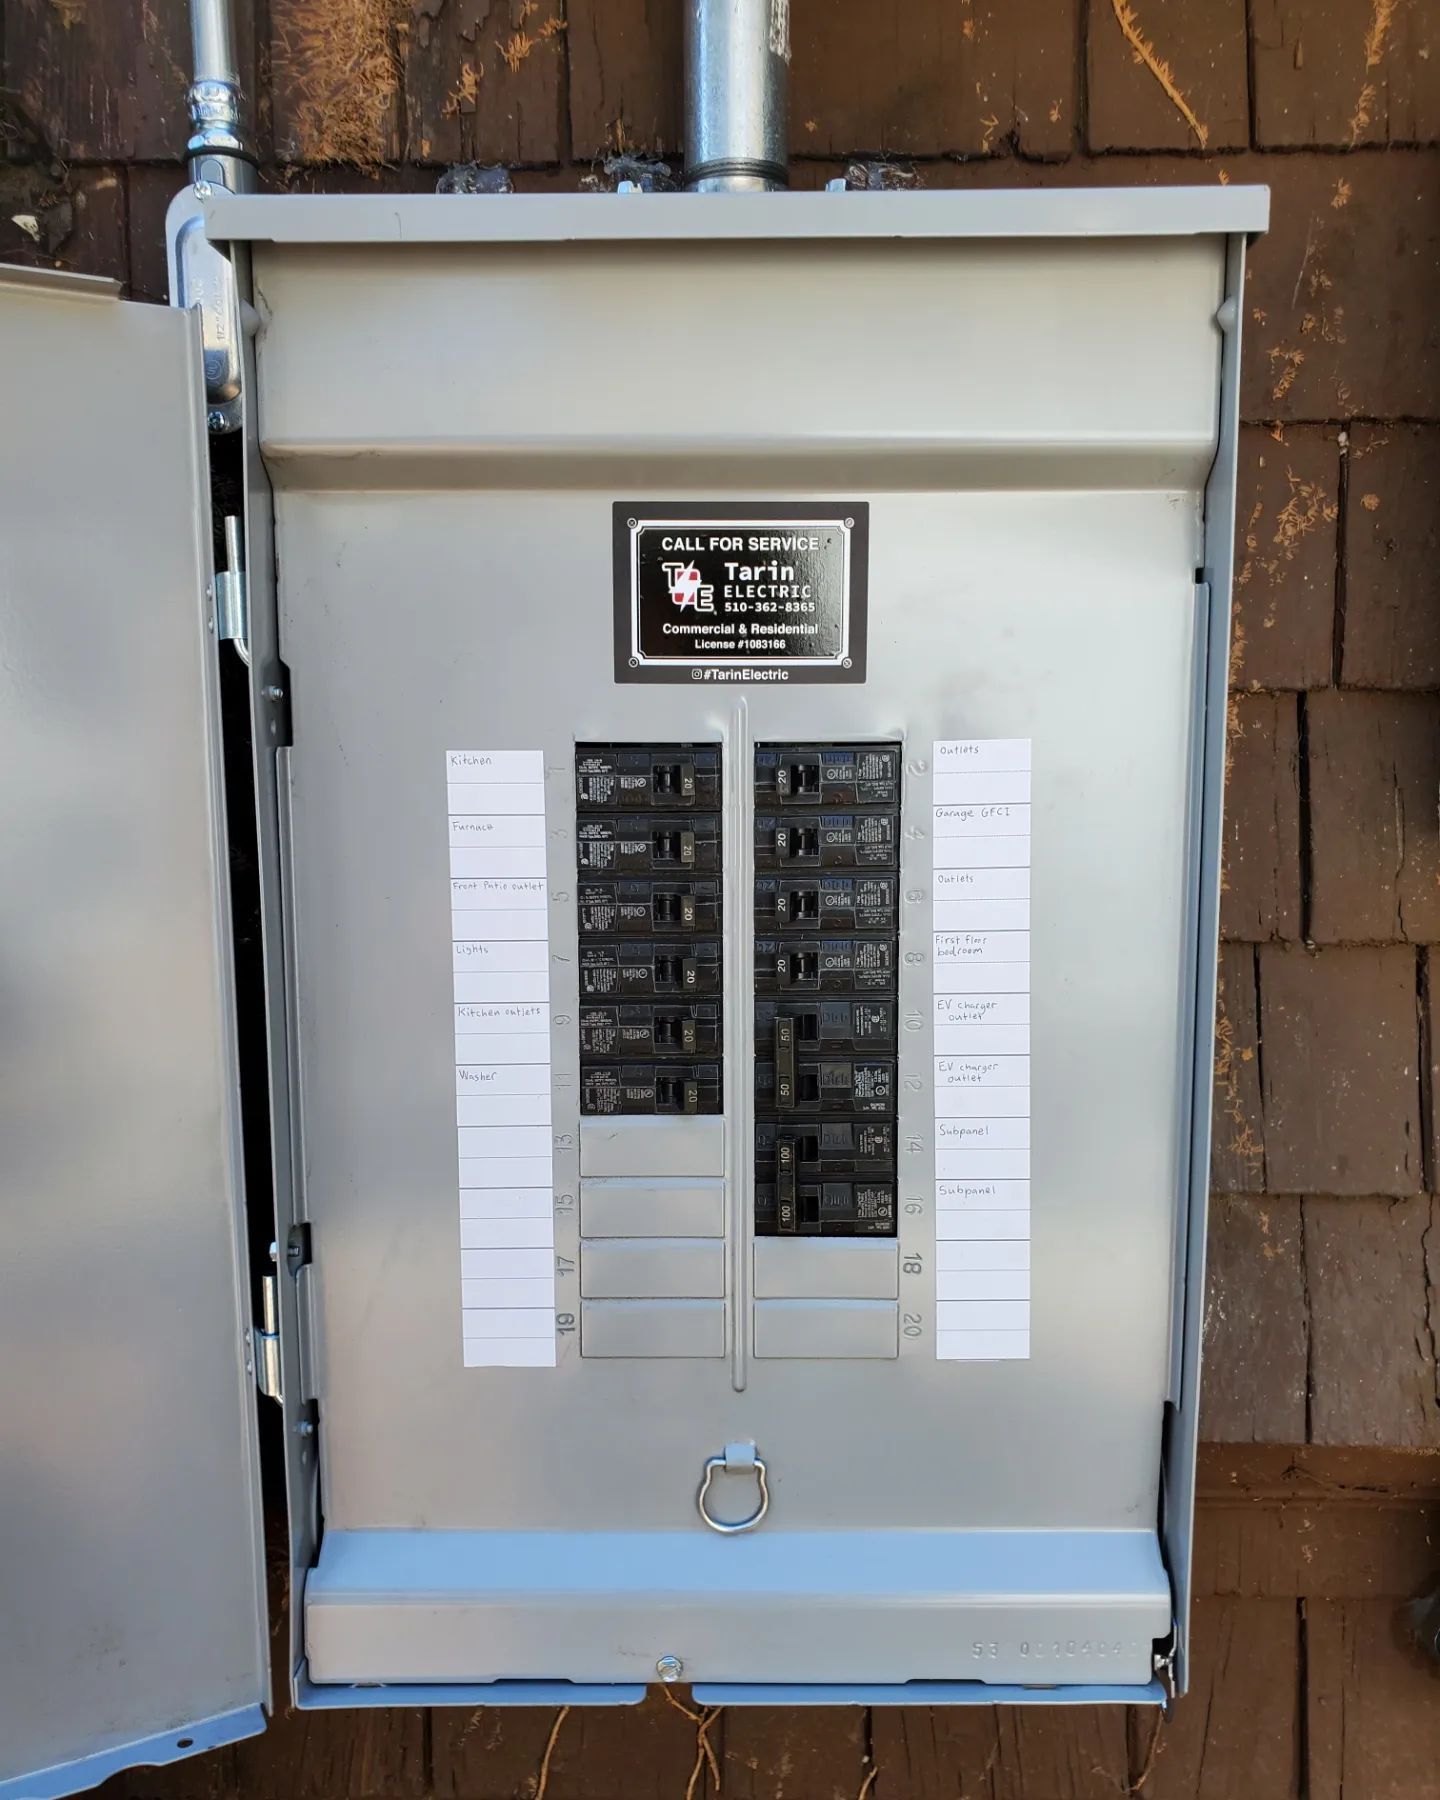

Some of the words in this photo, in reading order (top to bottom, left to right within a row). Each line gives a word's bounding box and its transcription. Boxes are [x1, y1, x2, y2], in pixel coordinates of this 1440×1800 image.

[661, 537, 705, 551] CALL
[709, 537, 743, 551] FOR
[748, 537, 819, 551] SERVICE
[724, 560, 795, 581] Tarin
[724, 585, 812, 598] ELECTRIC
[724, 602, 816, 613] 510-362-8365
[662, 623, 735, 635] Commercial
[739, 624, 748, 635] &
[751, 623, 819, 635] Residential
[695, 639, 736, 649] License
[737, 639, 786, 650] #1083166
[703, 668, 789, 681] #TarinElectric
[940, 744, 979, 755] Outlets
[450, 753, 493, 766] Kitchen
[684, 778, 693, 789] 20
[777, 770, 787, 784] 20
[935, 808, 974, 821] Garage
[981, 807, 1010, 818] GFCI
[777, 833, 787, 847] 20
[683, 845, 692, 856] 20
[453, 881, 478, 890] Front
[937, 874, 974, 884] Outlets
[777, 898, 786, 912] 20
[684, 907, 693, 921] 20
[935, 935, 960, 945] First
[456, 945, 489, 955] Lights
[937, 946, 983, 957] bedroom
[904, 952, 925, 965] 8
[777, 959, 786, 973] 20
[686, 970, 696, 983] 20
[457, 1006, 501, 1017] Kitchen
[505, 1006, 541, 1017] outlets
[937, 999, 953, 1010] EV
[957, 1002, 997, 1015] charger
[552, 1014, 572, 1025] 9
[904, 1009, 924, 1032] 10
[948, 1012, 983, 1021] outlet
[684, 1029, 694, 1043] 20
[780, 1028, 790, 1042] 50
[938, 1061, 954, 1072] EV
[959, 1063, 999, 1074] charger
[458, 1070, 497, 1081] Washer
[904, 1072, 923, 1093] 12
[947, 1074, 982, 1083] outlet
[688, 1089, 698, 1103] 20
[780, 1083, 790, 1096] 50
[939, 1124, 989, 1139] Subpanel
[554, 1133, 573, 1154] 13
[904, 1133, 924, 1154] 14
[780, 1147, 790, 1163] 100
[939, 1184, 996, 1198] Subpanel
[554, 1194, 574, 1214] 15
[903, 1195, 924, 1218] 16
[781, 1205, 791, 1222] 100
[556, 1255, 575, 1277] 17
[902, 1252, 923, 1275] 18
[555, 1312, 576, 1336] 19
[903, 1313, 923, 1338] 20
